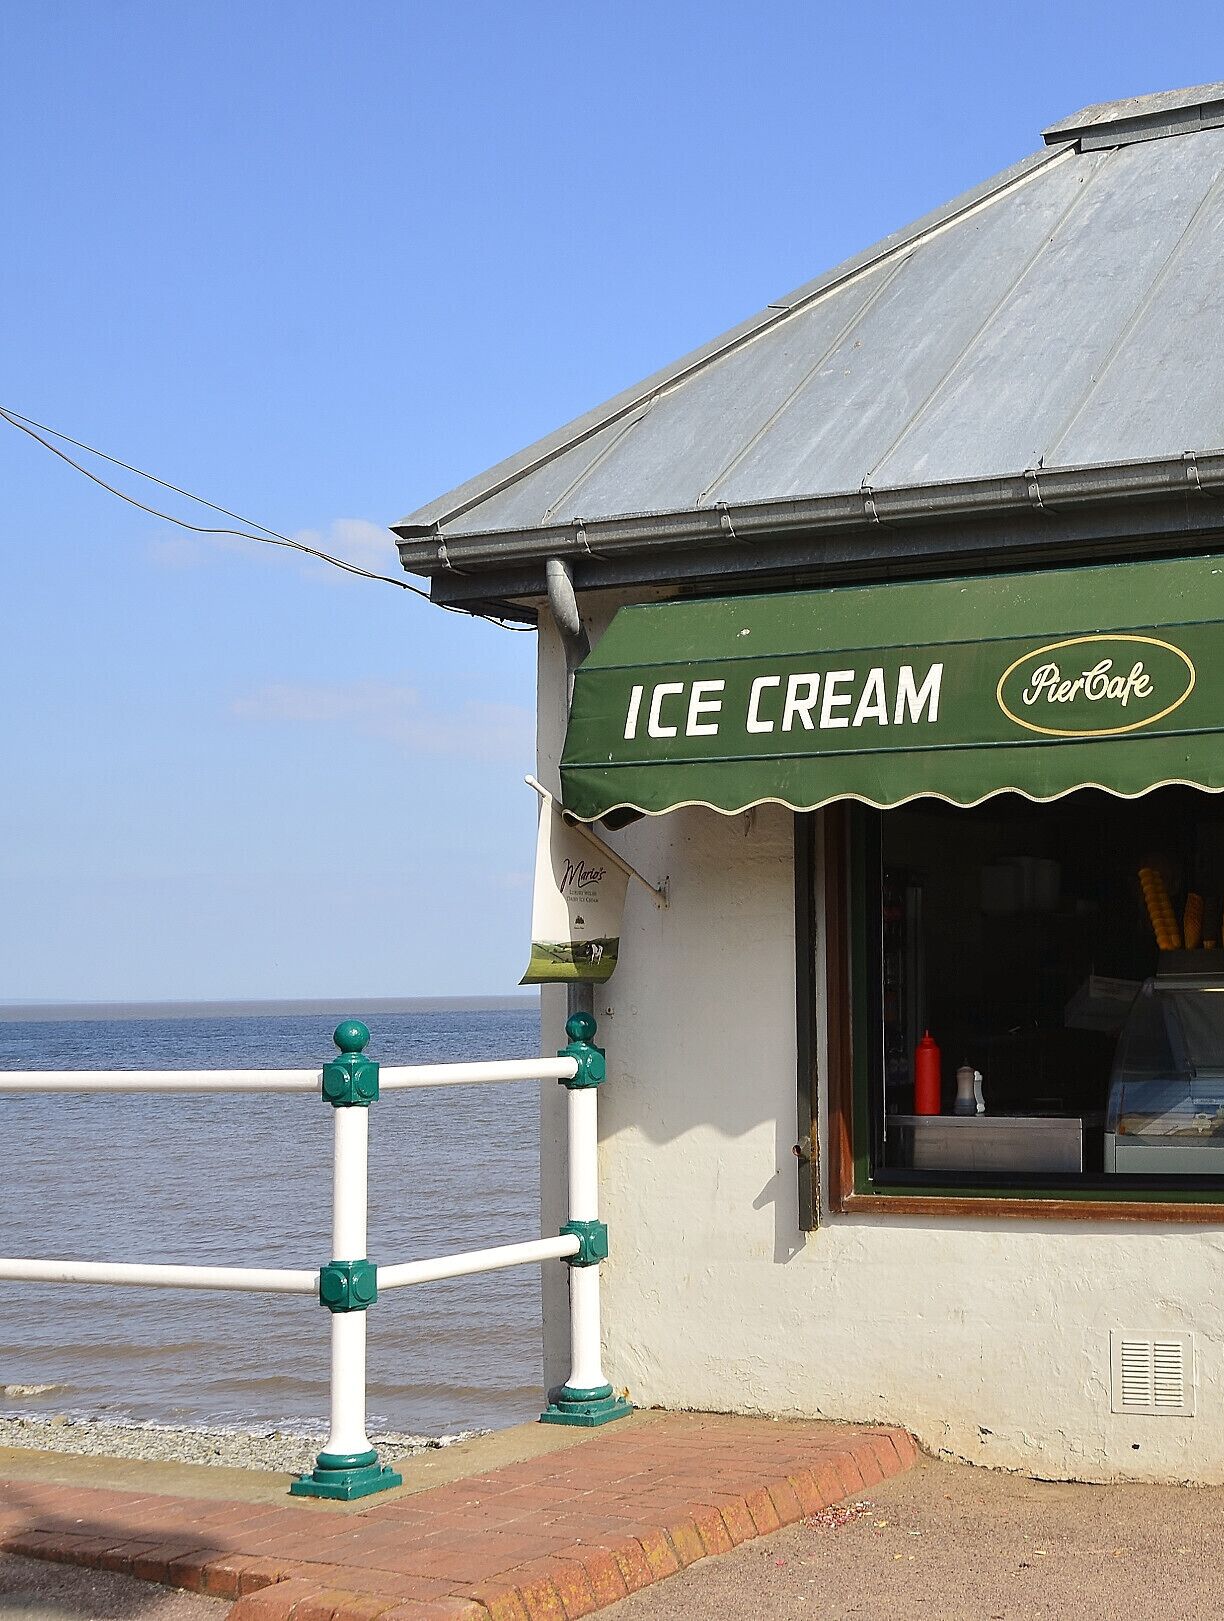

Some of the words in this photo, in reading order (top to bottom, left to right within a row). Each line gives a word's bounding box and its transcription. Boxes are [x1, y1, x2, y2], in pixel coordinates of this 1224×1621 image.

[624, 679, 726, 740] ICE
[746, 662, 944, 734] CREAM
[560, 859, 606, 893] Mario's
